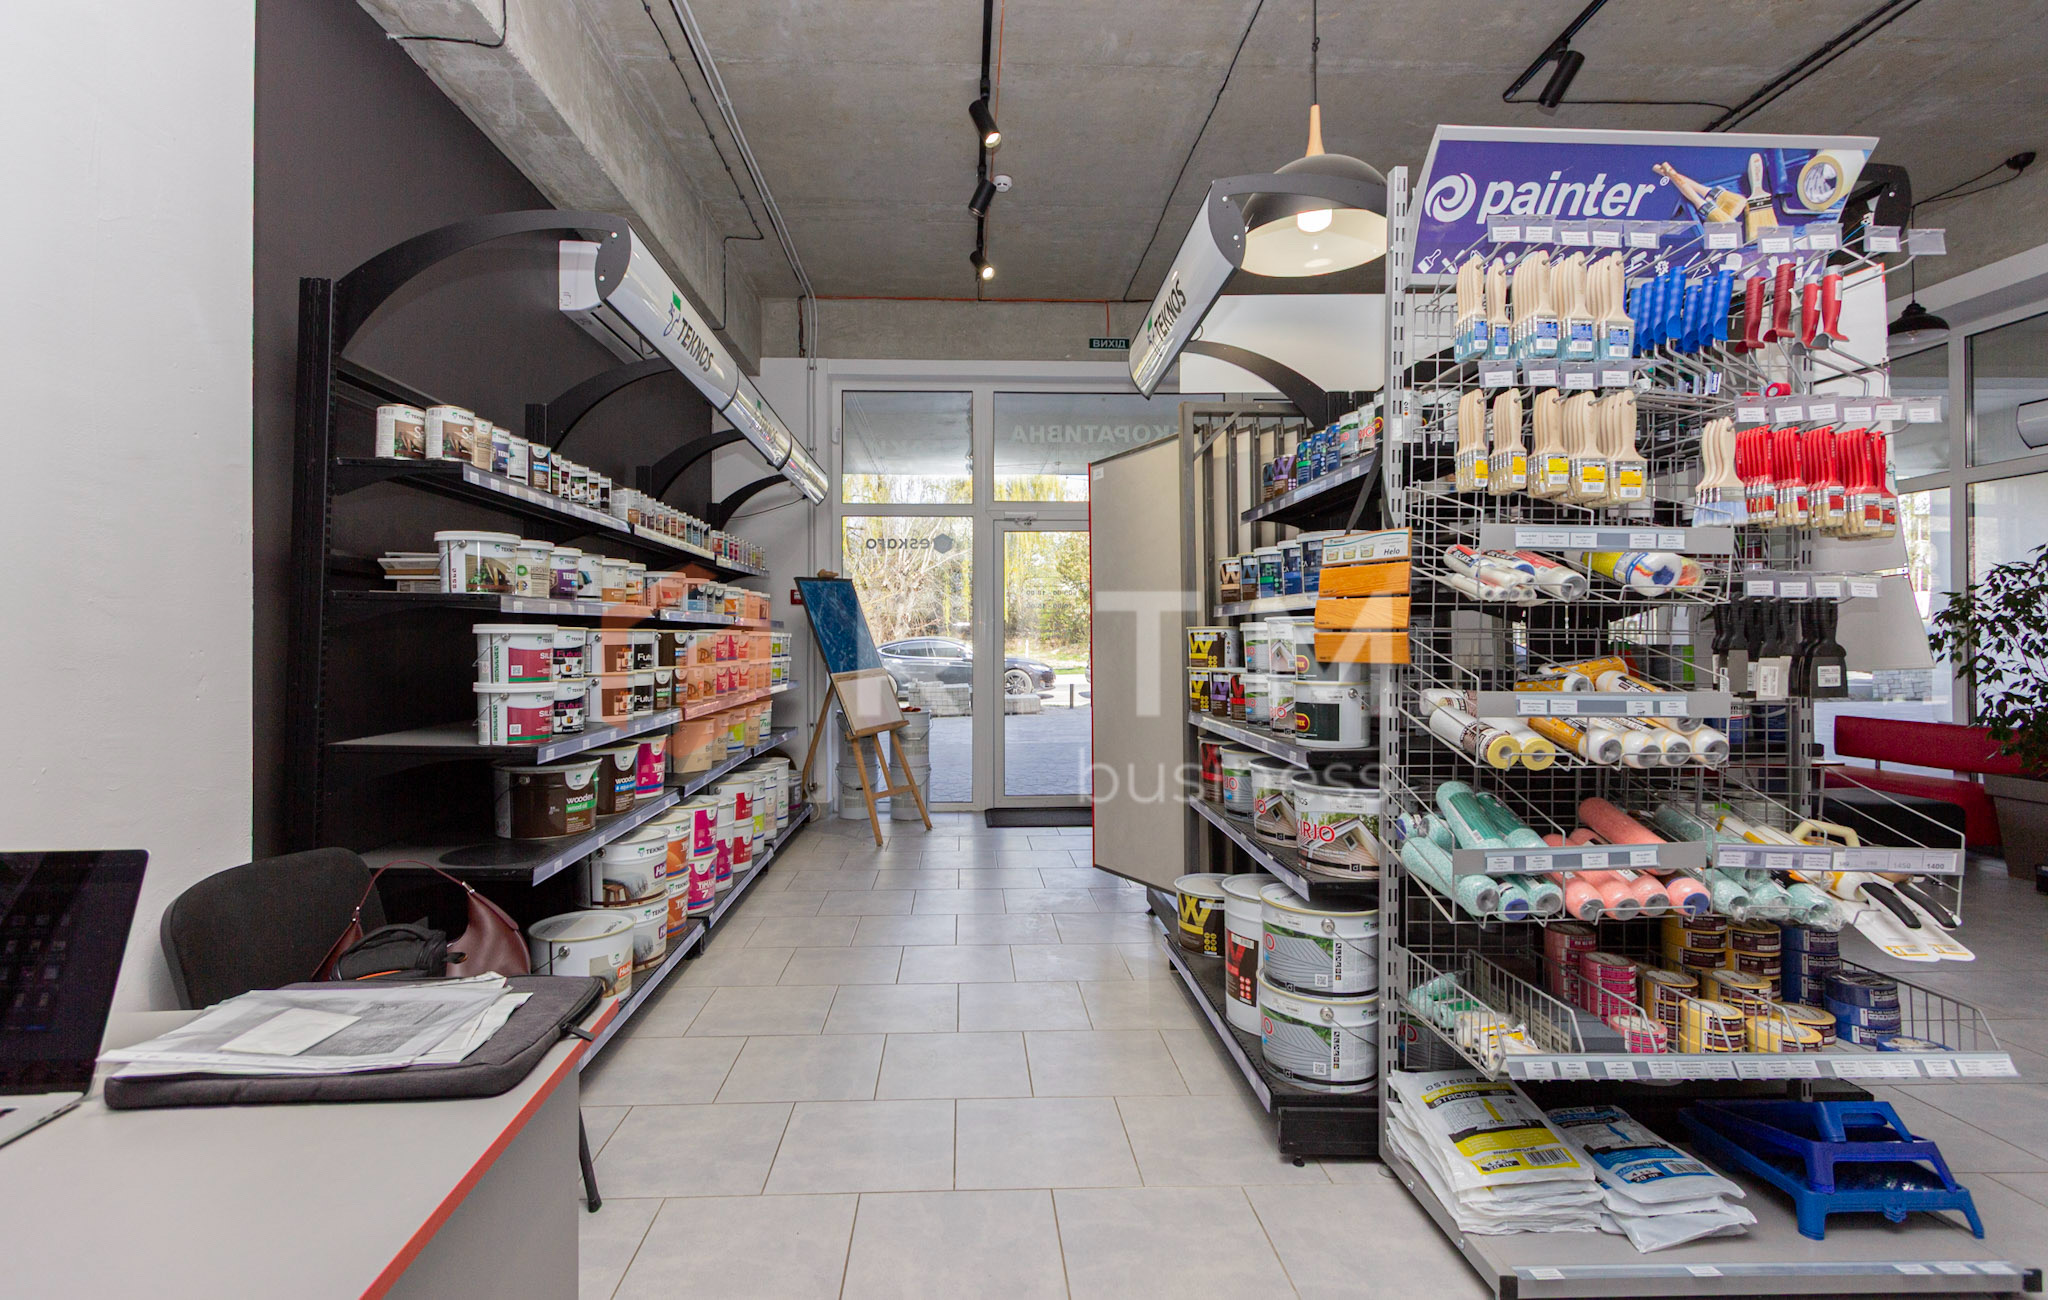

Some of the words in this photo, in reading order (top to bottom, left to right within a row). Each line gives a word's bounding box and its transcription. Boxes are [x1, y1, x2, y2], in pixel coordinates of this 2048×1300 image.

[1476, 170, 1655, 224] painter
[1153, 278, 1188, 341] TEKNOS
[675, 317, 715, 373] TEKNOS
[1092, 339, 1126, 349] ВИХІД
[1383, 548, 1401, 556] Helo
[1426, 1077, 1473, 1092] OSTERO
[1433, 1090, 1480, 1106] STRONG
